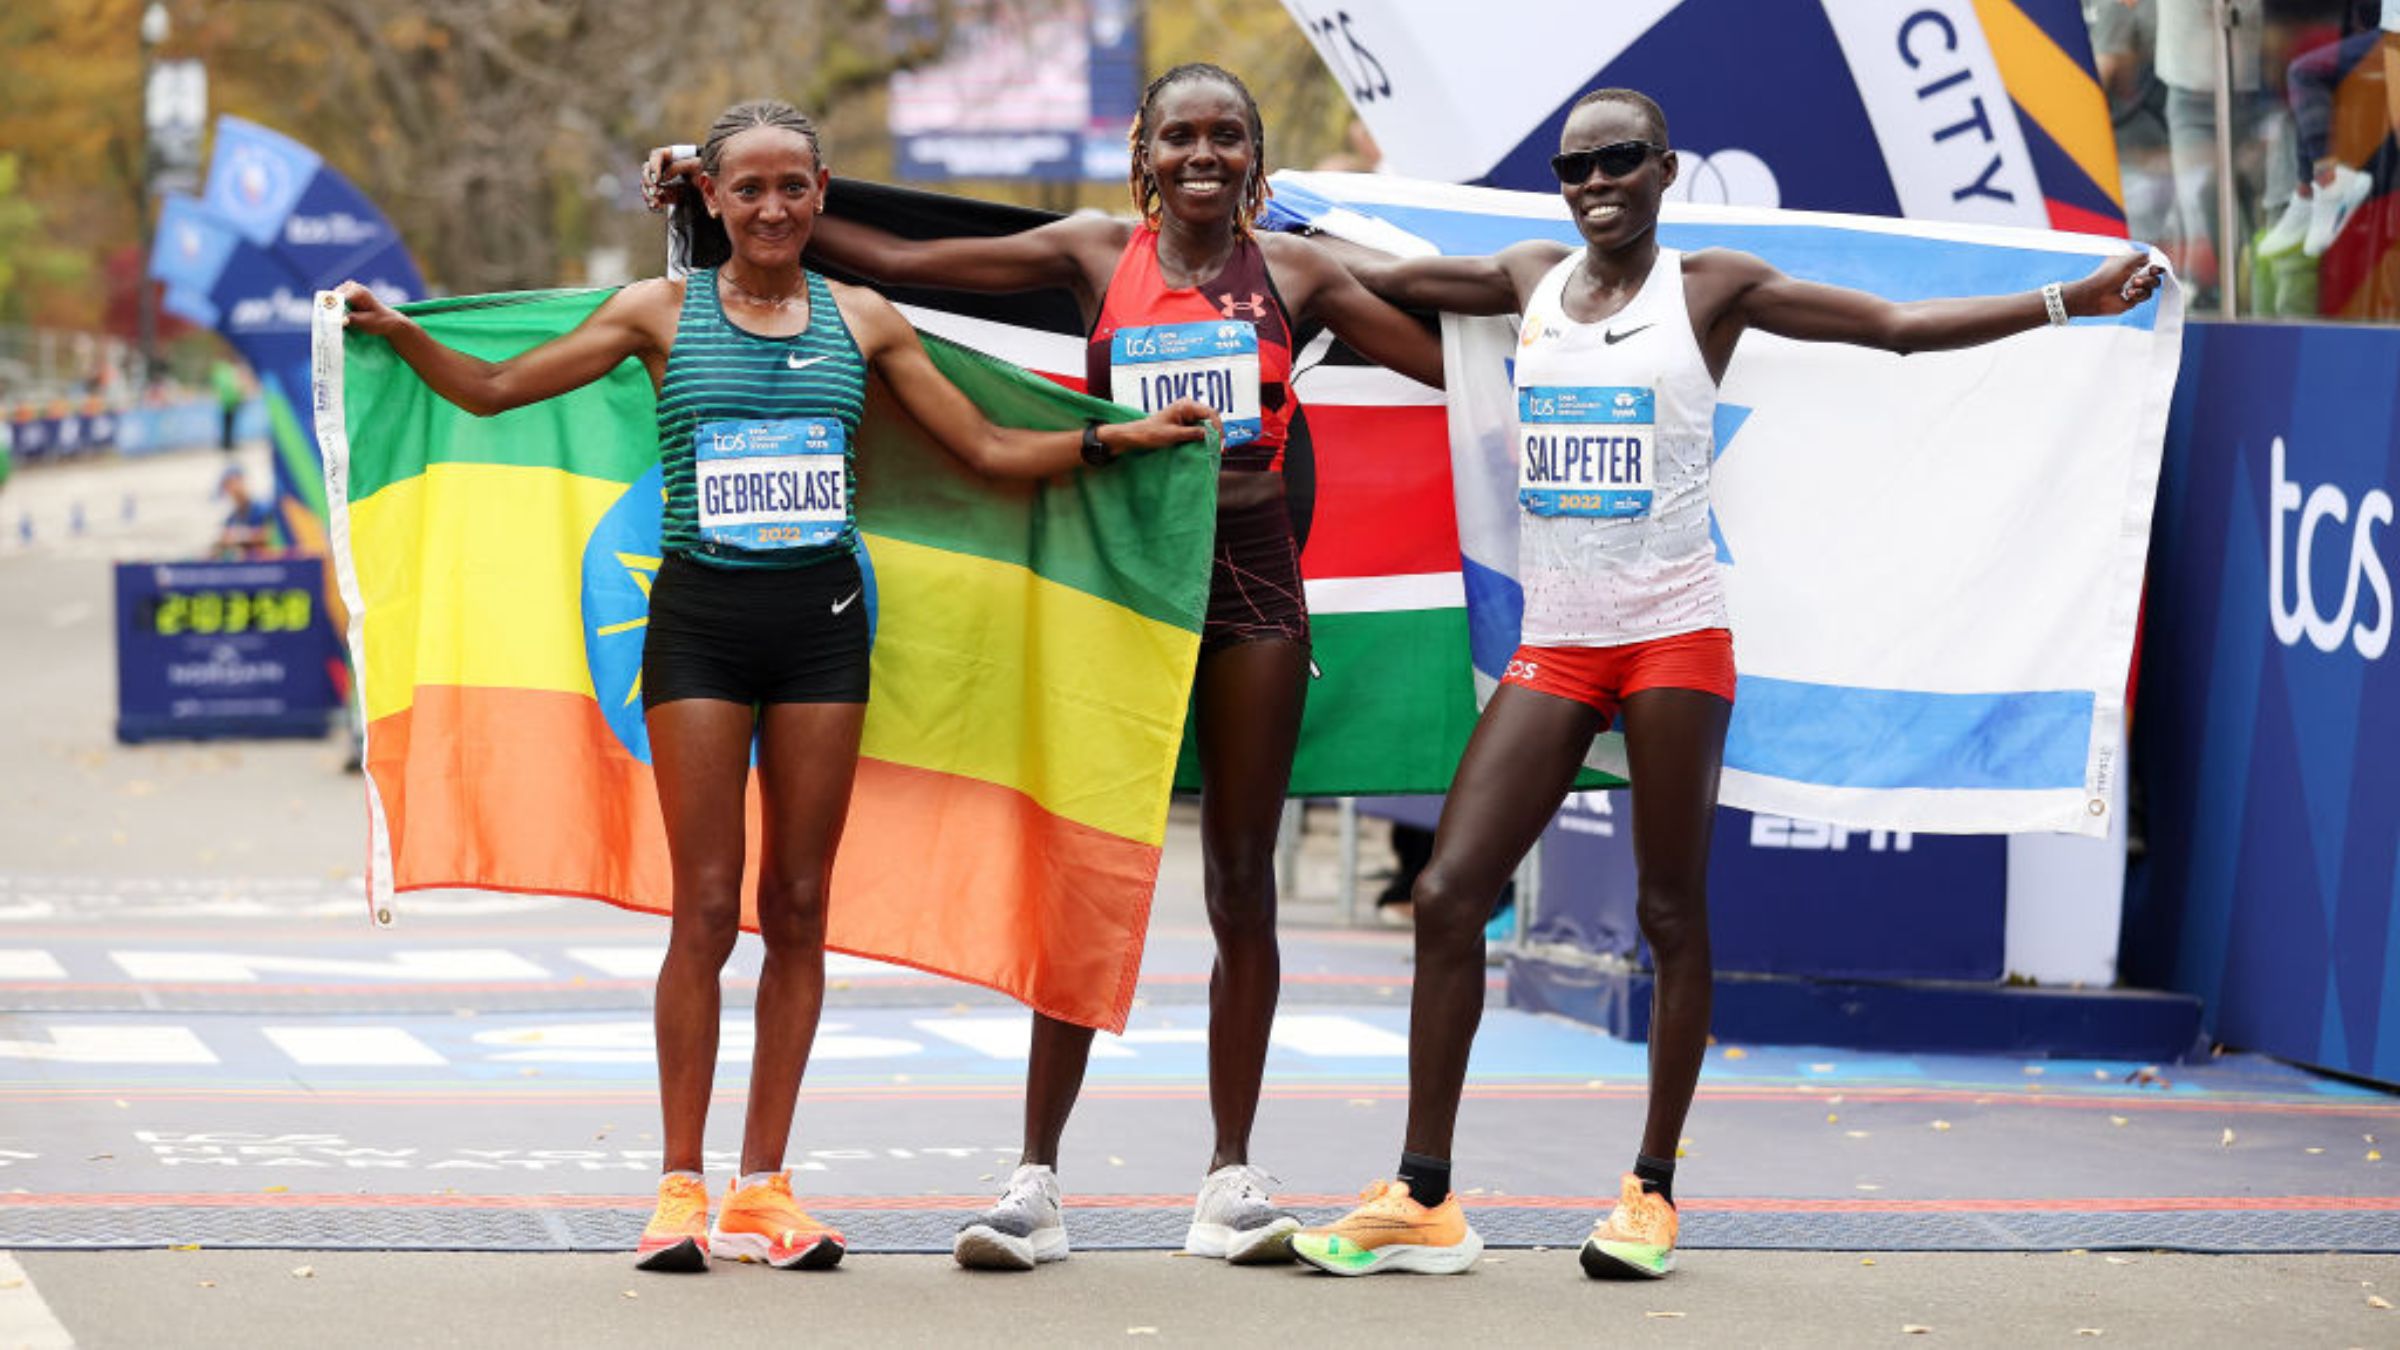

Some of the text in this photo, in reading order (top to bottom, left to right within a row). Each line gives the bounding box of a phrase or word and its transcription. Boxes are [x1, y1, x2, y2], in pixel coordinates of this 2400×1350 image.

[1897, 9, 2015, 205] CITY
[1123, 336, 1157, 357] tcs
[1141, 369, 1233, 413] LOKEDI
[1530, 395, 1555, 416] tcs
[713, 432, 747, 452] tcs
[1527, 435, 1642, 484] SALPETER
[705, 470, 842, 516] GEBRESLASE
[1558, 495, 1602, 510] 2022
[757, 527, 802, 543] 2022
[2270, 436, 2394, 660] tcs
[151, 1145, 419, 1157] NEW
